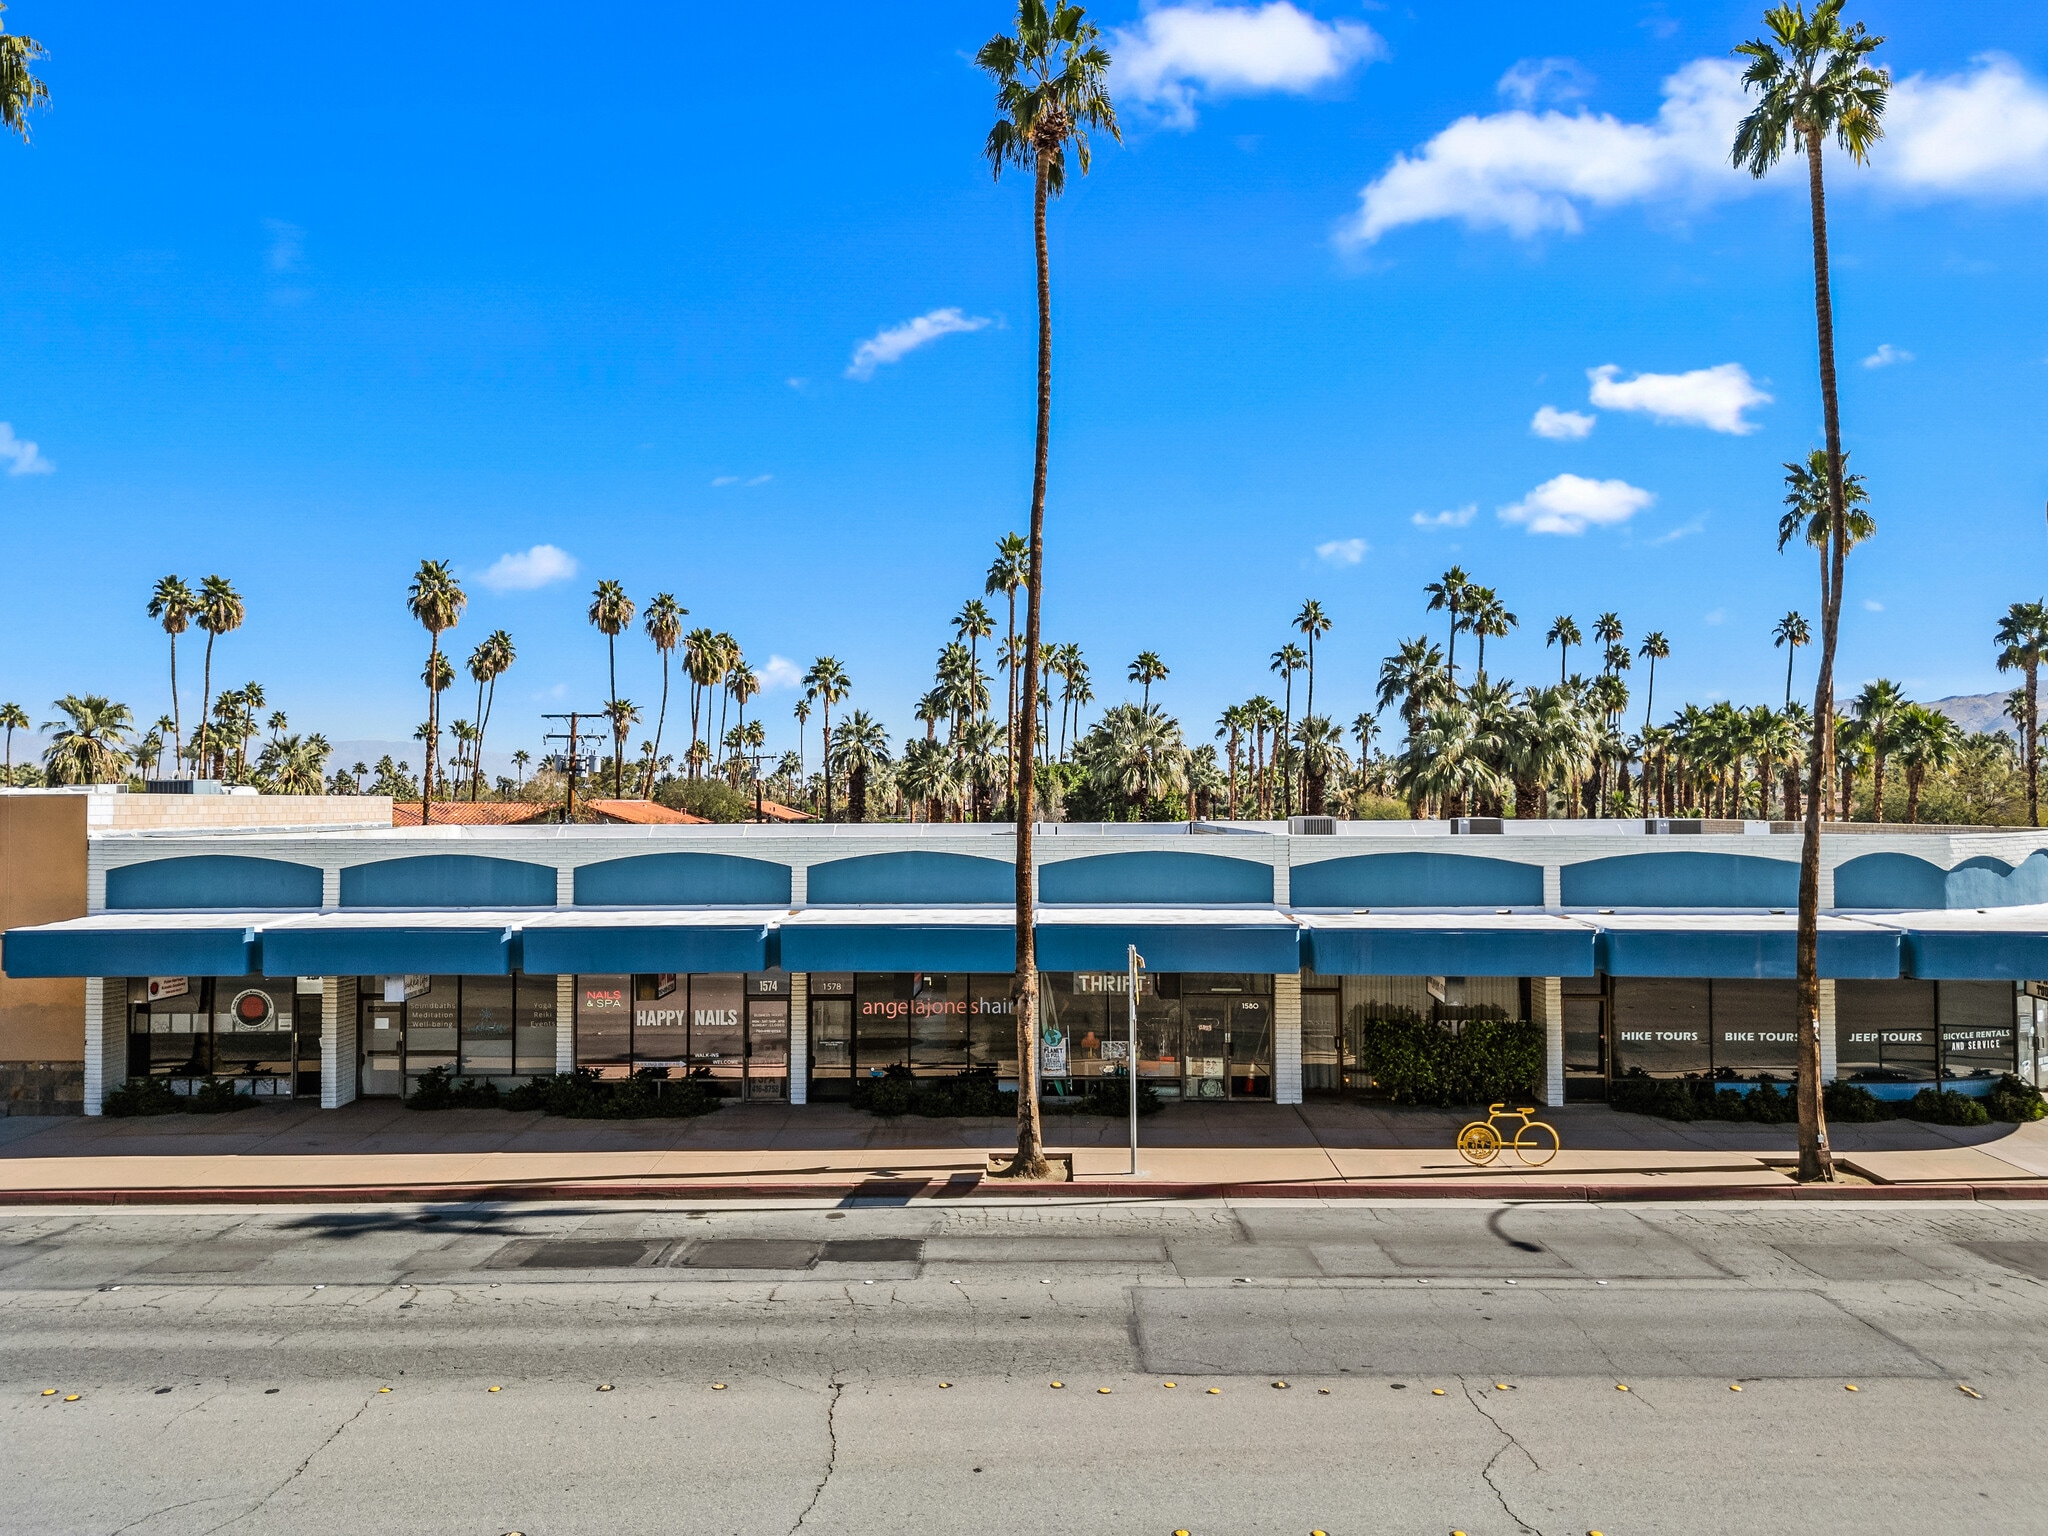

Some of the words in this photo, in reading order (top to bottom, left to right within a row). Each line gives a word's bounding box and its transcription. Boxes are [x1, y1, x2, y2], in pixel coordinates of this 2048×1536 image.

[759, 980, 778, 992] 1574
[822, 982, 842, 991] 1578
[1078, 975, 1146, 992] THRIFT
[586, 990, 621, 999] NAILS
[533, 1002, 552, 1010] Yoga
[596, 999, 621, 1008] SPA
[636, 1010, 685, 1026] HAPPY
[694, 1009, 738, 1026] NAILS
[412, 1021, 453, 1029] Well-being
[530, 1020, 555, 1028] Events
[1621, 1031, 1652, 1041] HIKE
[1655, 1031, 1698, 1041] TOURS
[1725, 1032, 1755, 1041] BIKE
[1848, 1033, 1879, 1042] JEEP
[1880, 1032, 1922, 1042] TOURS
[1943, 1031, 1974, 1040] BICYCLE
[1975, 1029, 2010, 1038] RENTALS
[1951, 1042, 1965, 1051] AND
[1967, 1039, 2000, 1050] SERVICE
